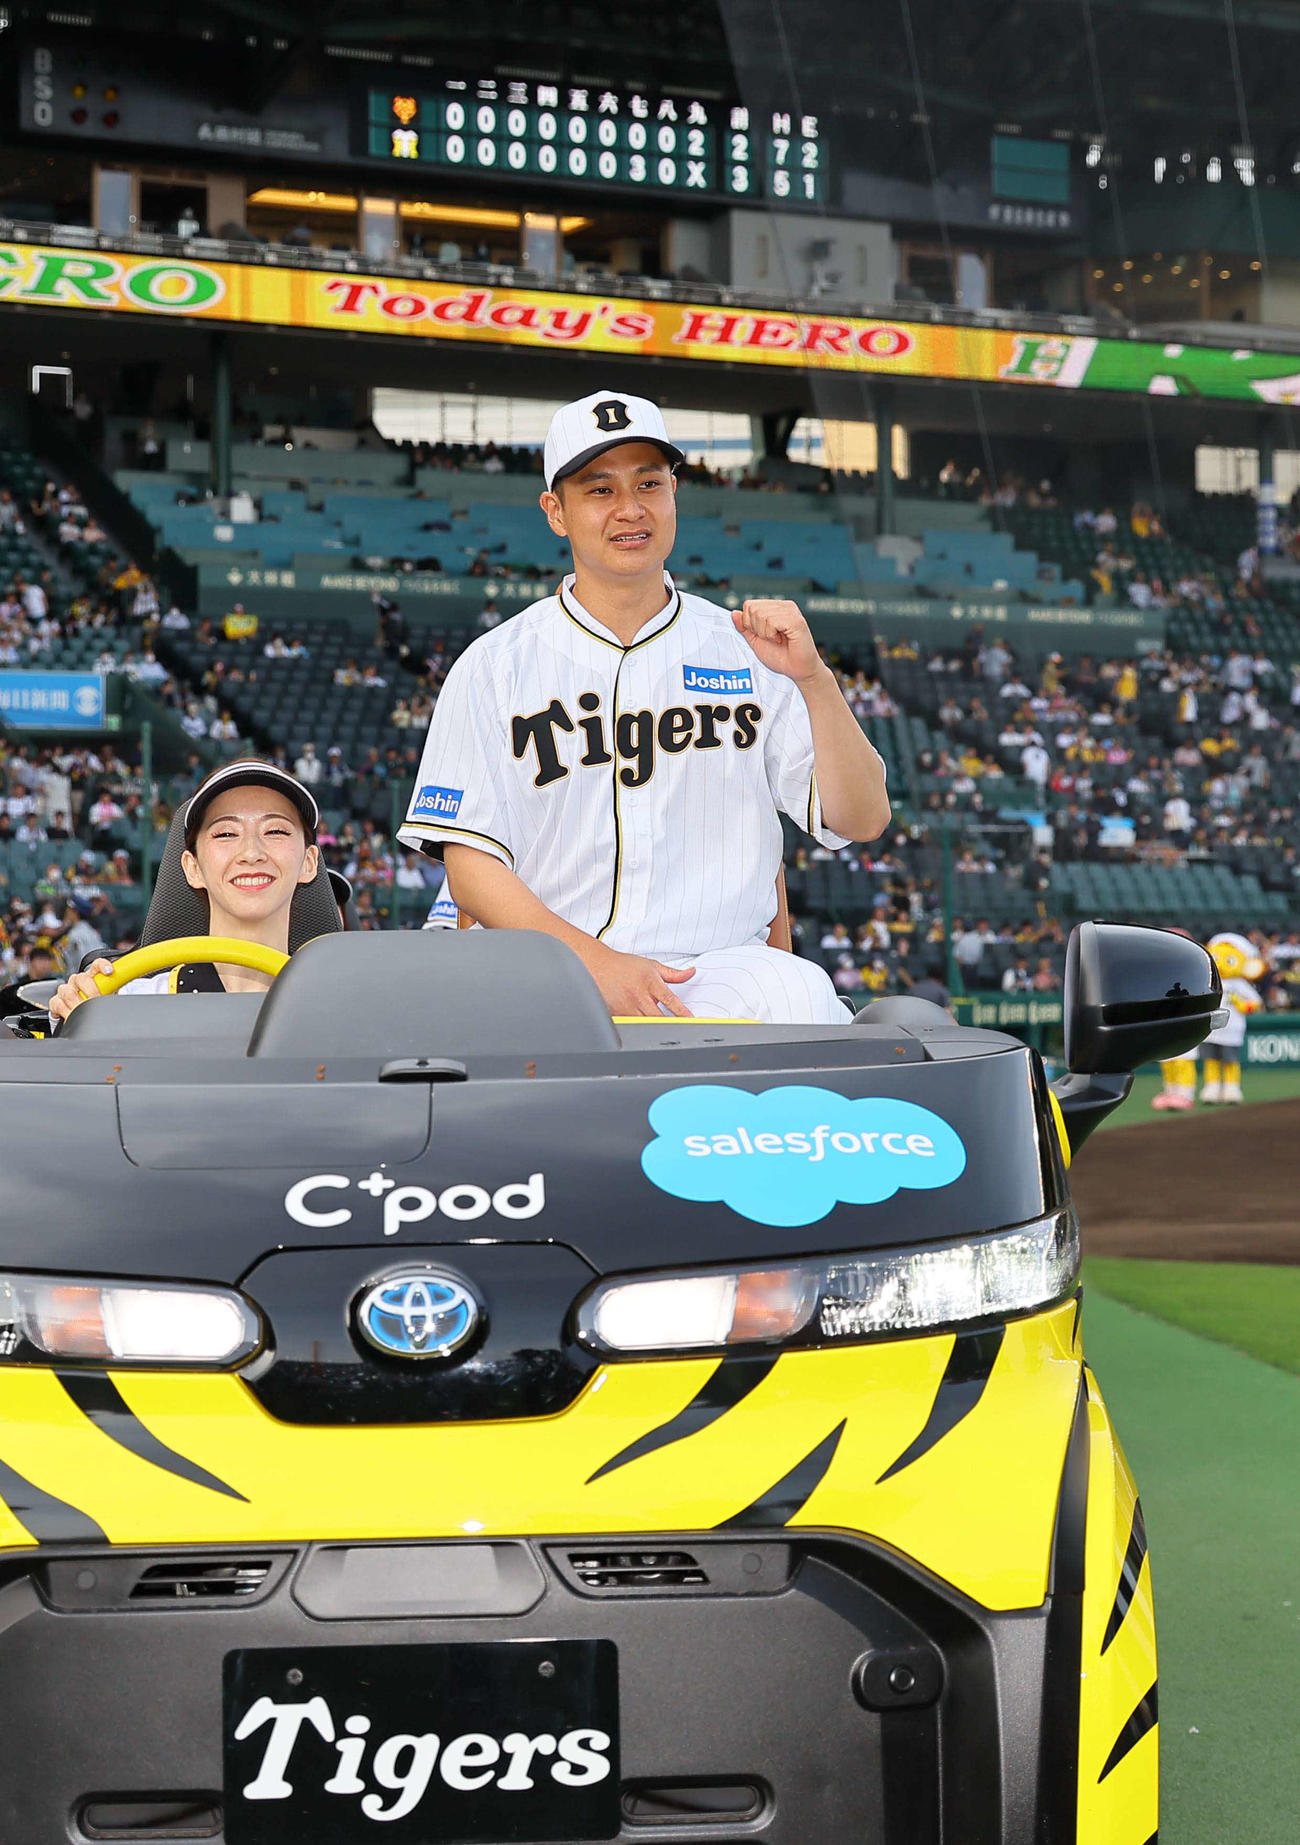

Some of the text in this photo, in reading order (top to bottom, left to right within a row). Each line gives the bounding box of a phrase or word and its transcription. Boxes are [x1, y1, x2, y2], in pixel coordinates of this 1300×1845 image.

[445, 102, 465, 131] 0
[476, 105, 496, 134] 0
[507, 109, 527, 137] 0
[538, 112, 557, 140] 0
[568, 116, 587, 144] 0
[598, 119, 617, 147] 0
[628, 122, 647, 150] 0
[657, 125, 677, 153] 0
[687, 129, 705, 156] 2
[731, 133, 749, 161] 2
[772, 138, 790, 165] 7
[801, 141, 819, 168] 2
[476, 79, 498, 100] 二
[772, 112, 791, 135] H
[801, 115, 819, 138] E
[446, 134, 465, 163] 0
[477, 138, 496, 166] 0
[507, 141, 527, 169] 0
[538, 144, 557, 173] 0
[568, 148, 587, 176] 0
[598, 151, 617, 179] 0
[629, 154, 647, 182] 3
[658, 157, 677, 185] 0
[686, 160, 707, 188] X
[731, 165, 749, 192] 3
[773, 169, 791, 197] 5
[802, 173, 815, 199] 1
[0, 248, 225, 312] RO
[325, 279, 915, 358] Today's HERO
[685, 671, 751, 690] Joshin
[511, 692, 763, 790] Tigers
[684, 1124, 934, 1162] salesforce
[234, 1696, 611, 1822] Tigers
